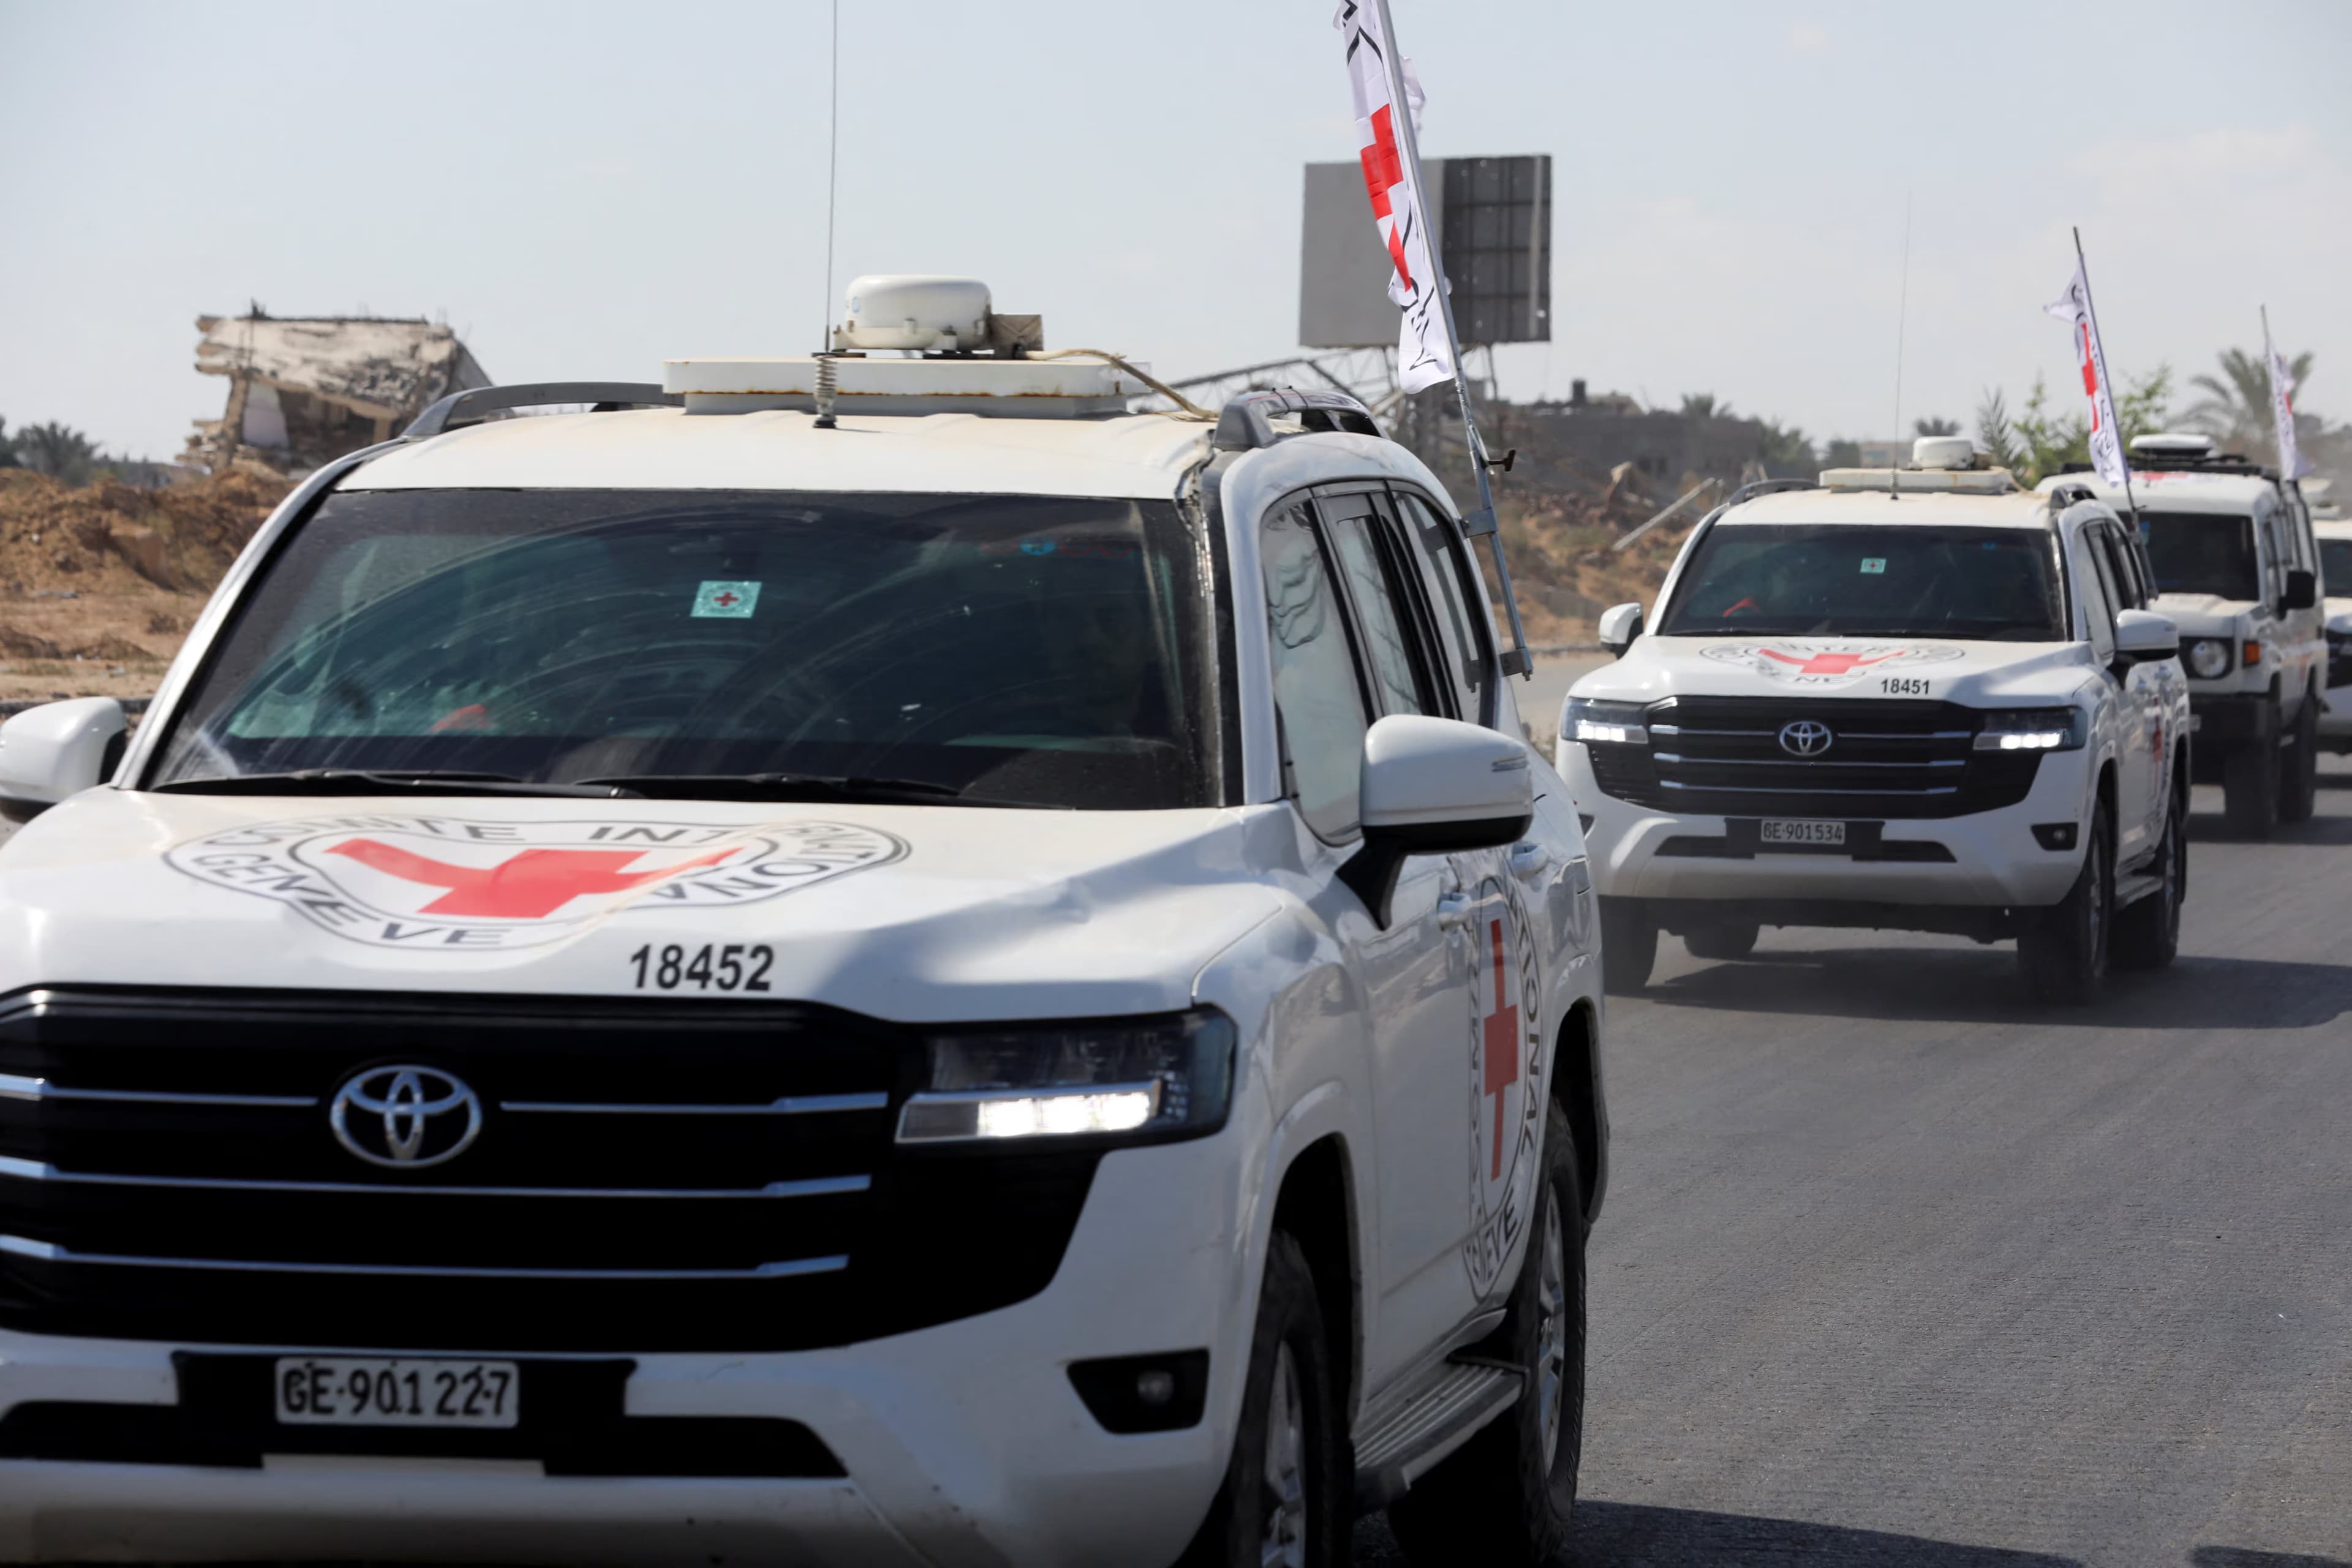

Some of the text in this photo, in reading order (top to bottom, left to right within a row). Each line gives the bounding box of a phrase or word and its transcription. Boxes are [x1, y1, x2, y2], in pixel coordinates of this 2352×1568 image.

[1880, 678, 1931, 695] 18451
[192, 853, 511, 945] GENEVE
[629, 943, 775, 992] 18452
